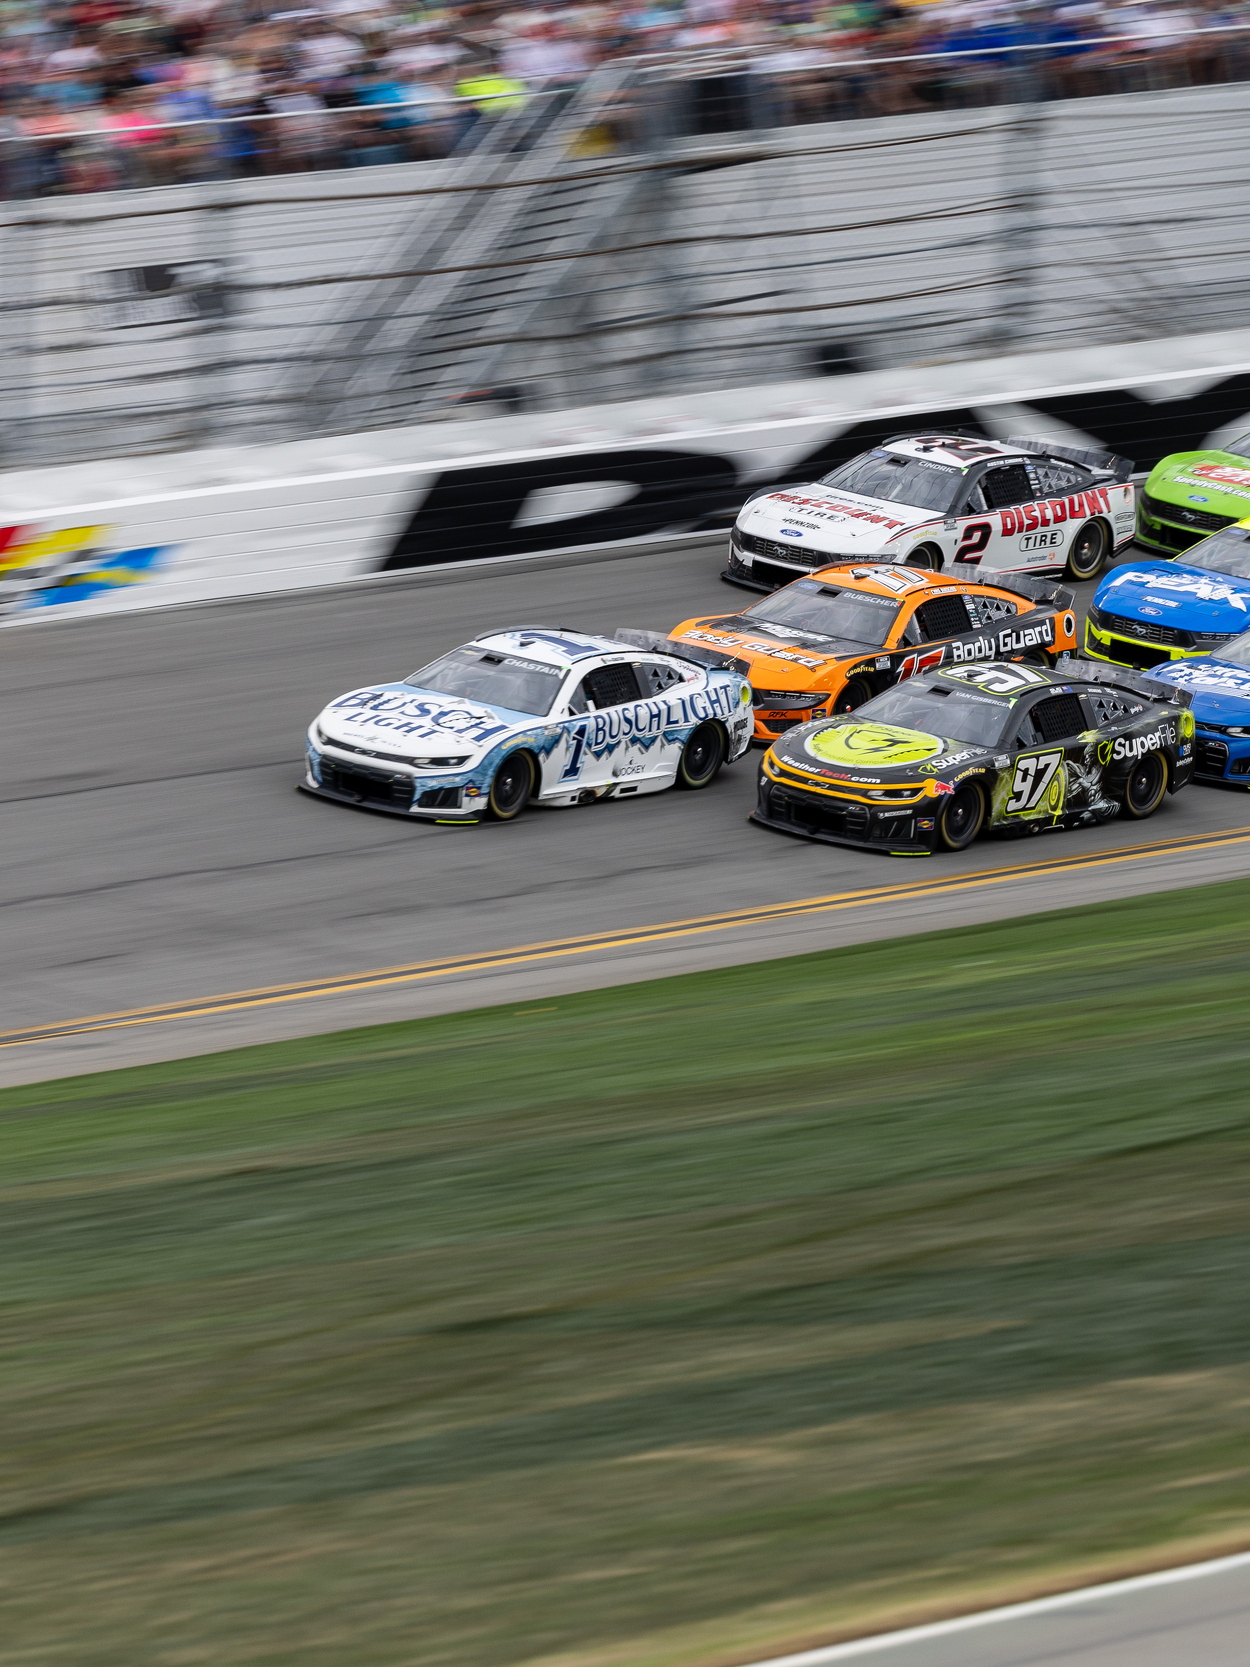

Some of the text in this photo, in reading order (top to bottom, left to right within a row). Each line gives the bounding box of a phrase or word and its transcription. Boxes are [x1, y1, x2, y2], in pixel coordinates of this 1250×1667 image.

[918, 460, 957, 474] CINDRIC
[767, 493, 905, 529] DISCOUNT
[1000, 487, 1112, 537] DISCOUNT
[782, 529, 802, 538] Ford
[953, 521, 992, 566] 2
[1024, 533, 1058, 549] TIRE
[844, 592, 899, 608] BUESCHER
[741, 642, 827, 668] Guard
[952, 619, 1053, 664] Body Guard
[503, 658, 564, 680] CHASTAIN
[847, 665, 875, 678] GOODYEAR
[956, 691, 971, 699] VAN
[330, 691, 511, 743] BUSCH
[344, 712, 445, 739] LIGHT
[592, 684, 735, 748] BUSCH LIGHT
[559, 721, 590, 783] 1
[1112, 722, 1177, 760] SuperFile
[780, 754, 882, 784] WeatherTech.com
[954, 767, 987, 782] GOODYEAR
[1005, 753, 1062, 811] 97
